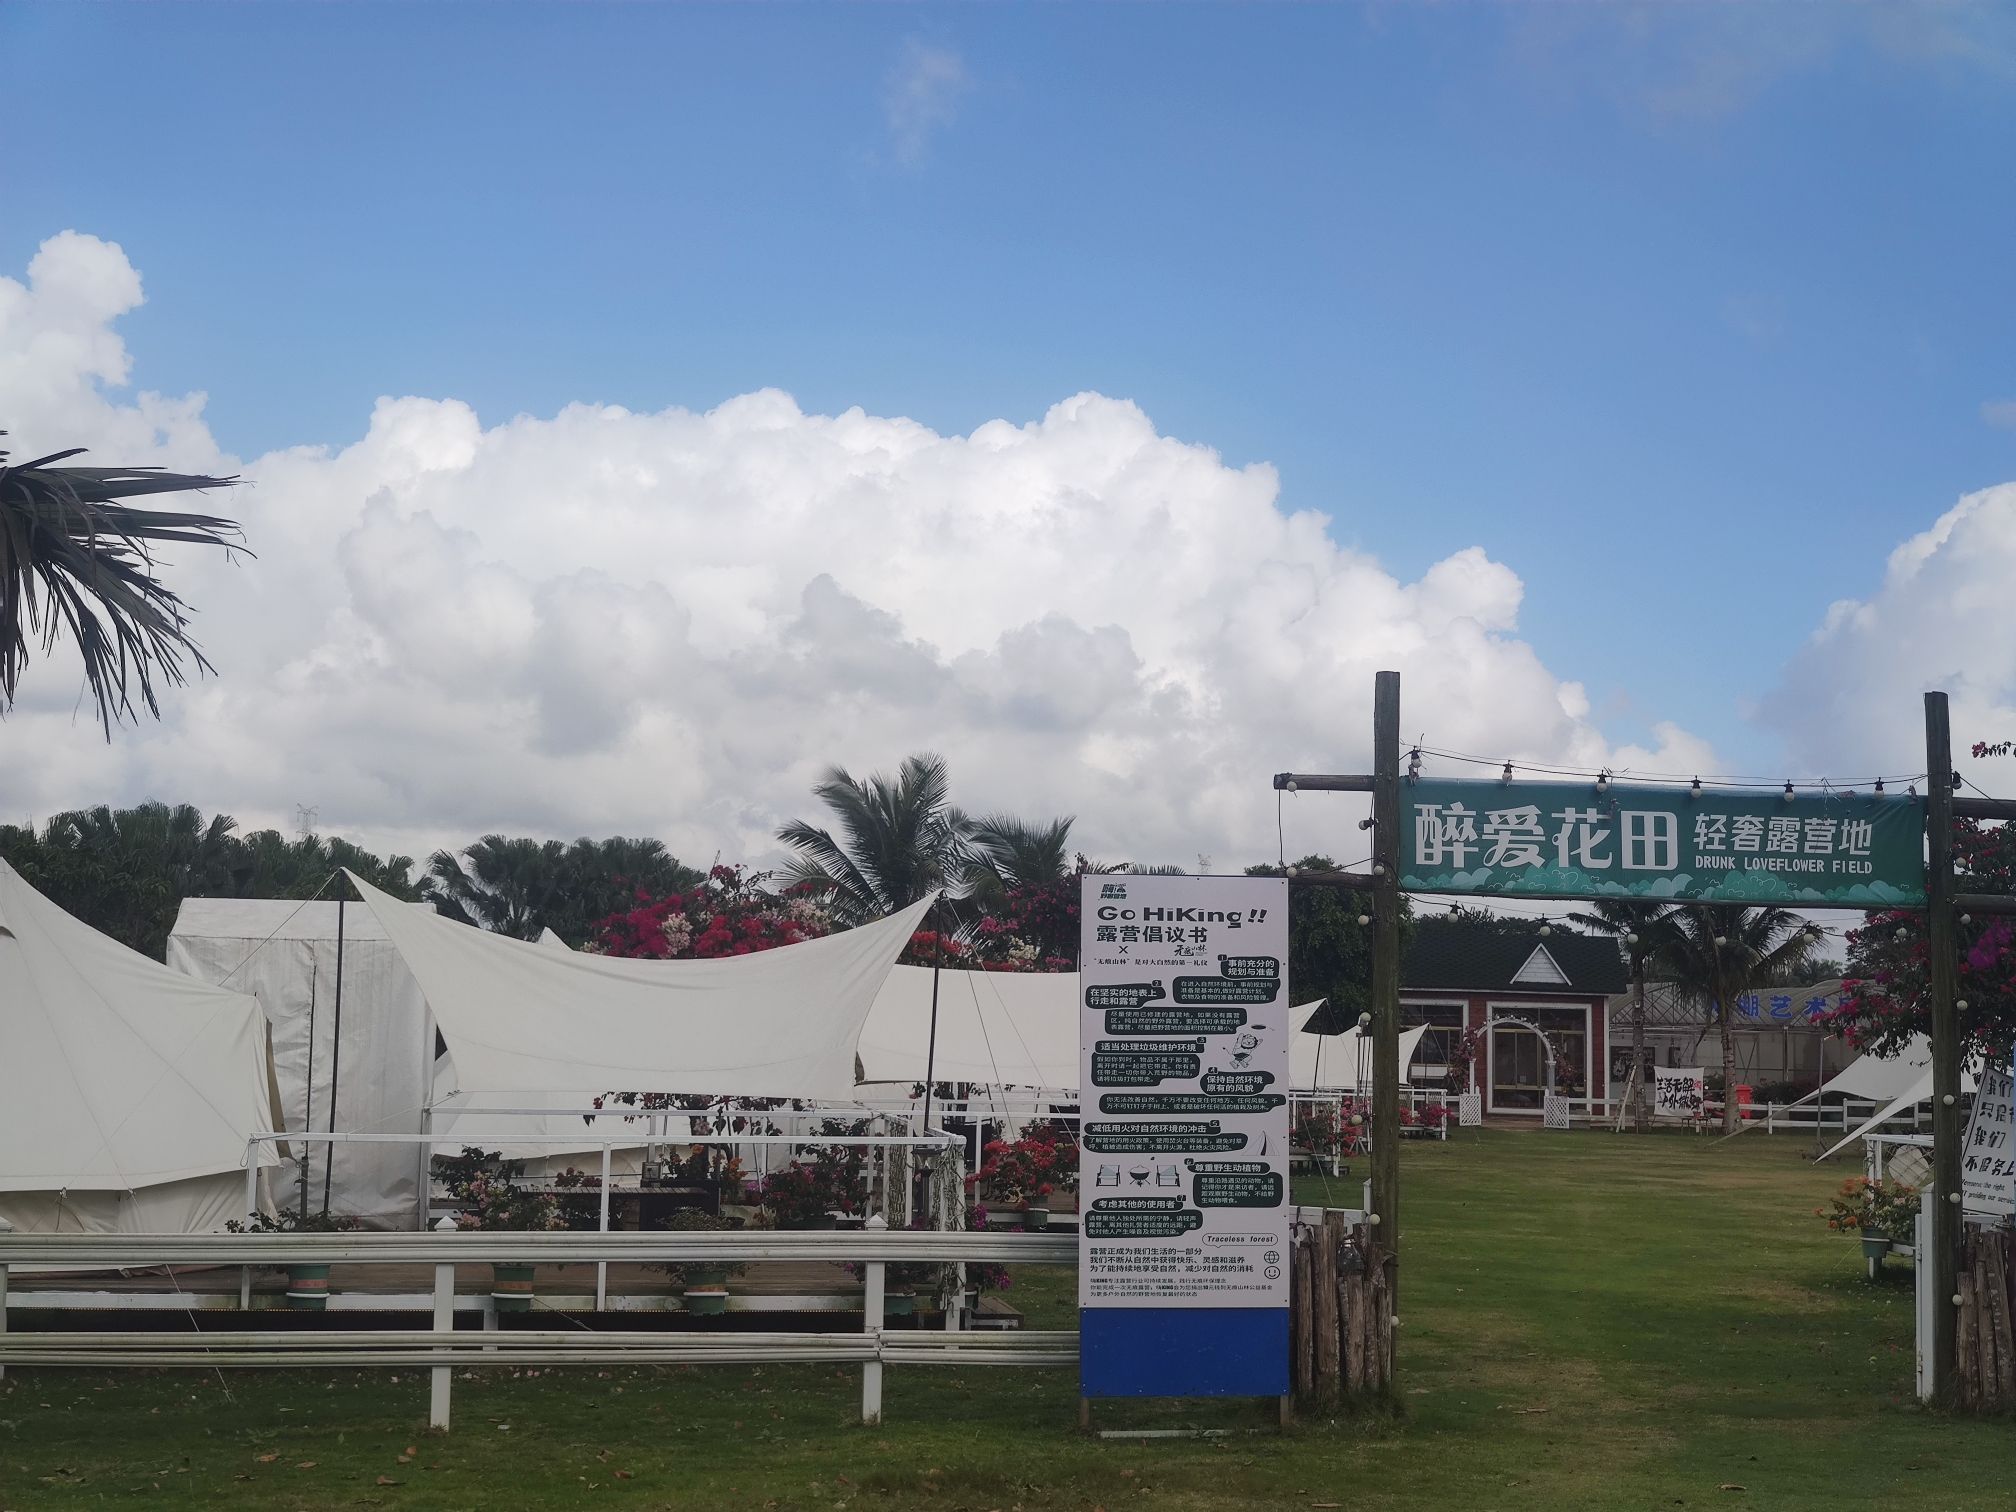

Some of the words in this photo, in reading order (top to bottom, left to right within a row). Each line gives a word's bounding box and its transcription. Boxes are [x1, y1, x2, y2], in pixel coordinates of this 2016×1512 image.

[1414, 801, 1680, 871] 醉爱花田
[1692, 812, 1873, 856] 轻奢露营地
[1695, 855, 1736, 870] DRUNK
[1744, 856, 1825, 873] LOVEFLOWER
[1832, 858, 1873, 875] FIELD
[1097, 905, 1136, 921] Go
[1096, 925, 1208, 943] 露营倡议书
[1134, 958, 1208, 967] 是对大自然的第一礼仪
[1227, 959, 1275, 968] 事前充分的
[1227, 968, 1275, 977] 规划与准备
[1090, 988, 1158, 997] 在坚实的地表上
[1090, 997, 1138, 1006] 行走和露营
[1100, 1042, 1197, 1052] 适当处理垃圾维护环境
[1206, 1075, 1264, 1084] 保持自然环境
[1206, 1083, 1254, 1093] 原有的风貌
[1091, 1124, 1207, 1133] 减低用火对自然环境的冲击
[1973, 1125, 2006, 1148] 我们
[1194, 1163, 1261, 1173] 尊重野生动植物
[1098, 1199, 1175, 1209] 考虑其他的使用者
[1250, 1235, 1274, 1243] forest
[1089, 1247, 1203, 1255] 露营正成为我们生活的一部分
[1089, 1256, 1245, 1264] 我们不断从自然中获得快乐、灵感和滋养
[1089, 1264, 1254, 1273] 为了能持续地享受自然，减少对自然的消耗
